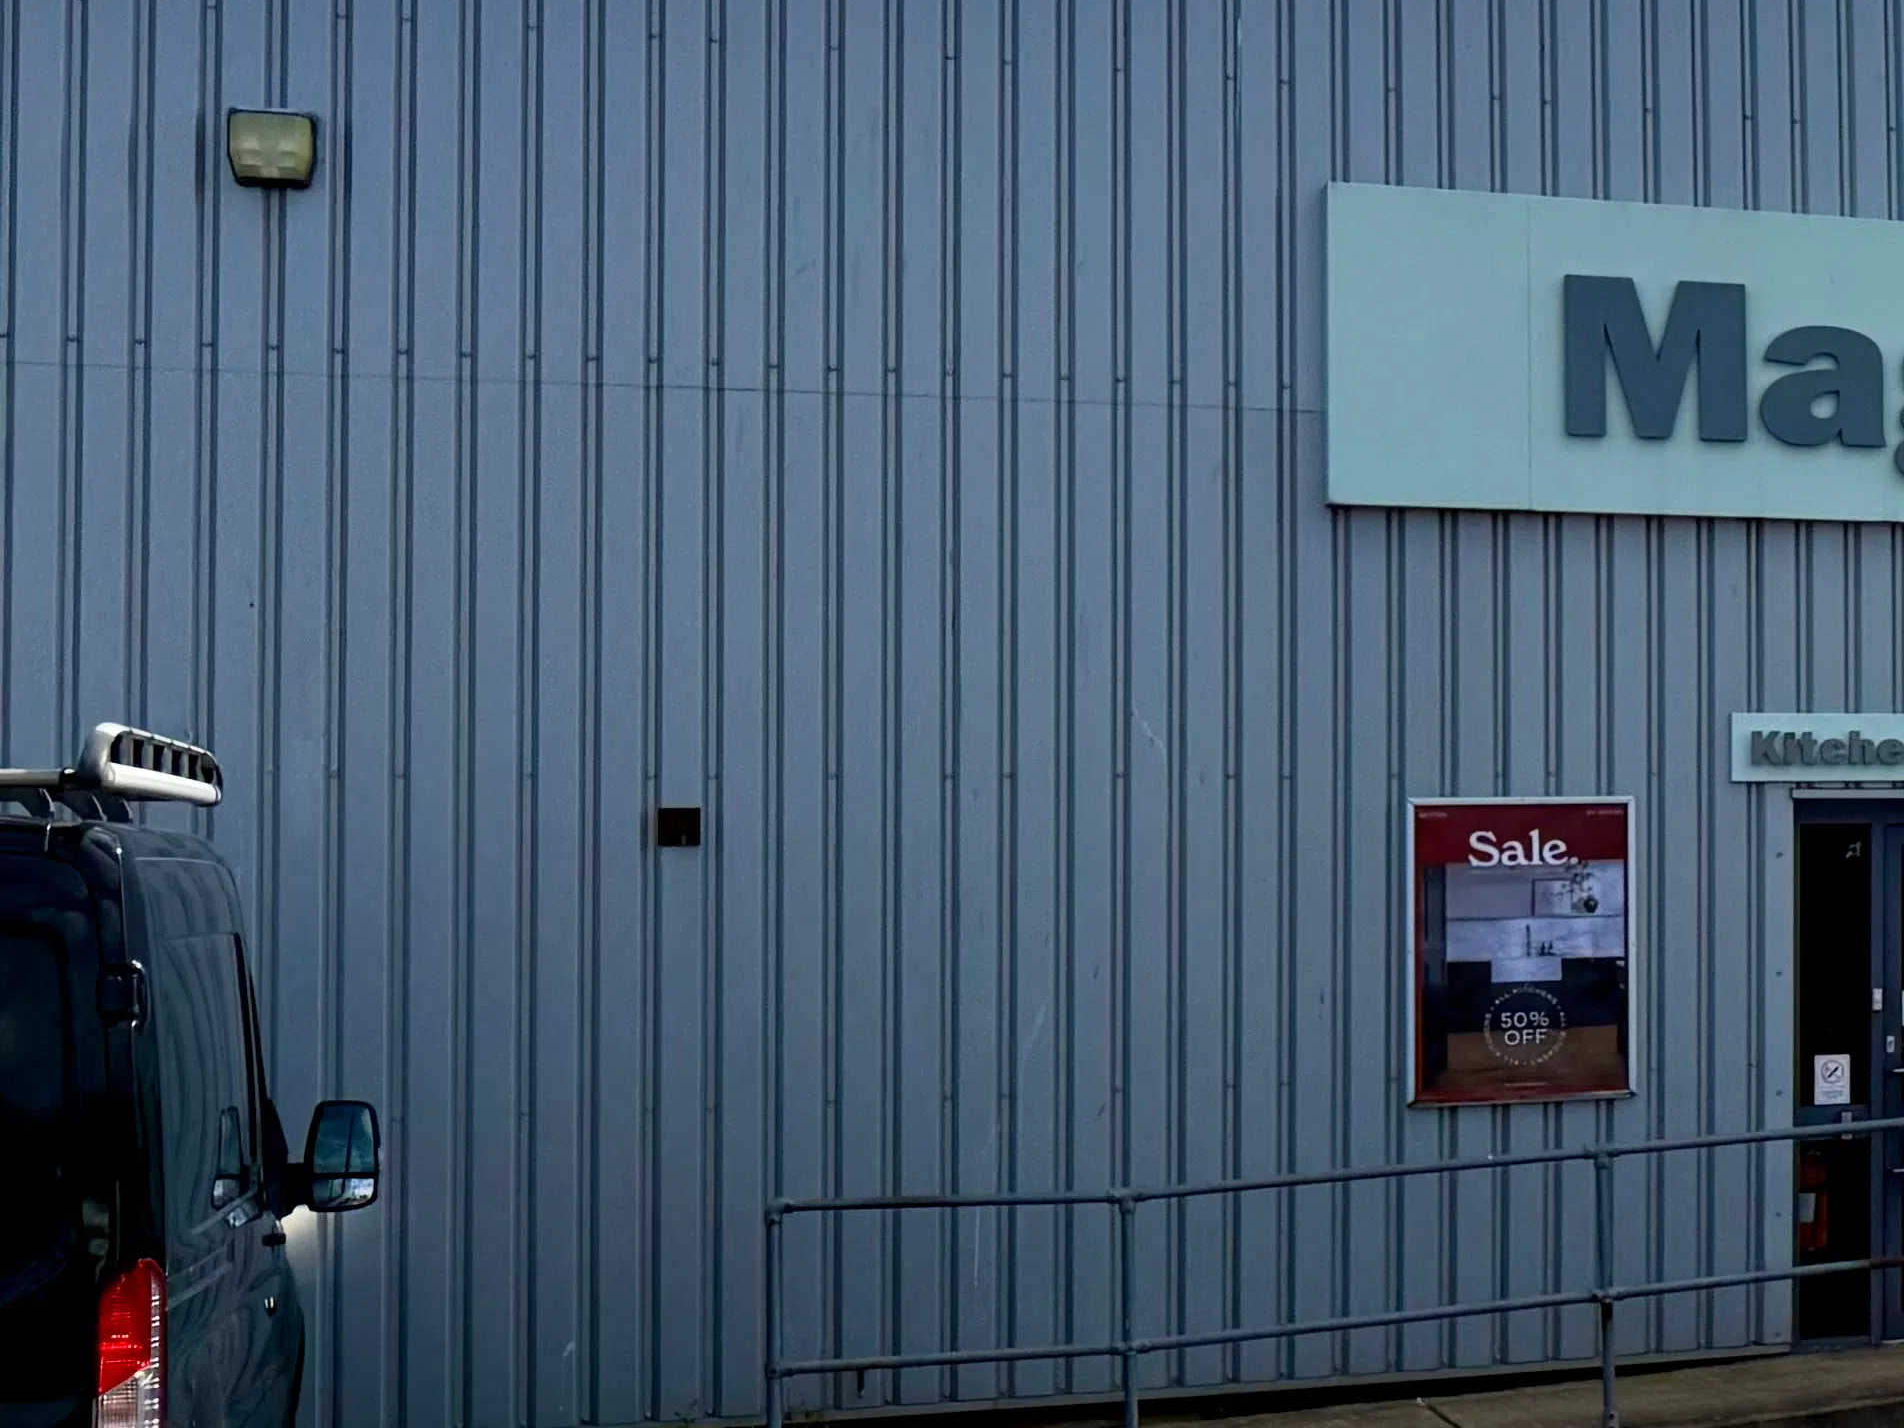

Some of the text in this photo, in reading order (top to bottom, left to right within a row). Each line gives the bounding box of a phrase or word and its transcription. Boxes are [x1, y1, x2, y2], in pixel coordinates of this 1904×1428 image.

[1468, 828, 1579, 867] Sale.
[1501, 1011, 1550, 1028] 50%
[1504, 1029, 1547, 1045] OFF
